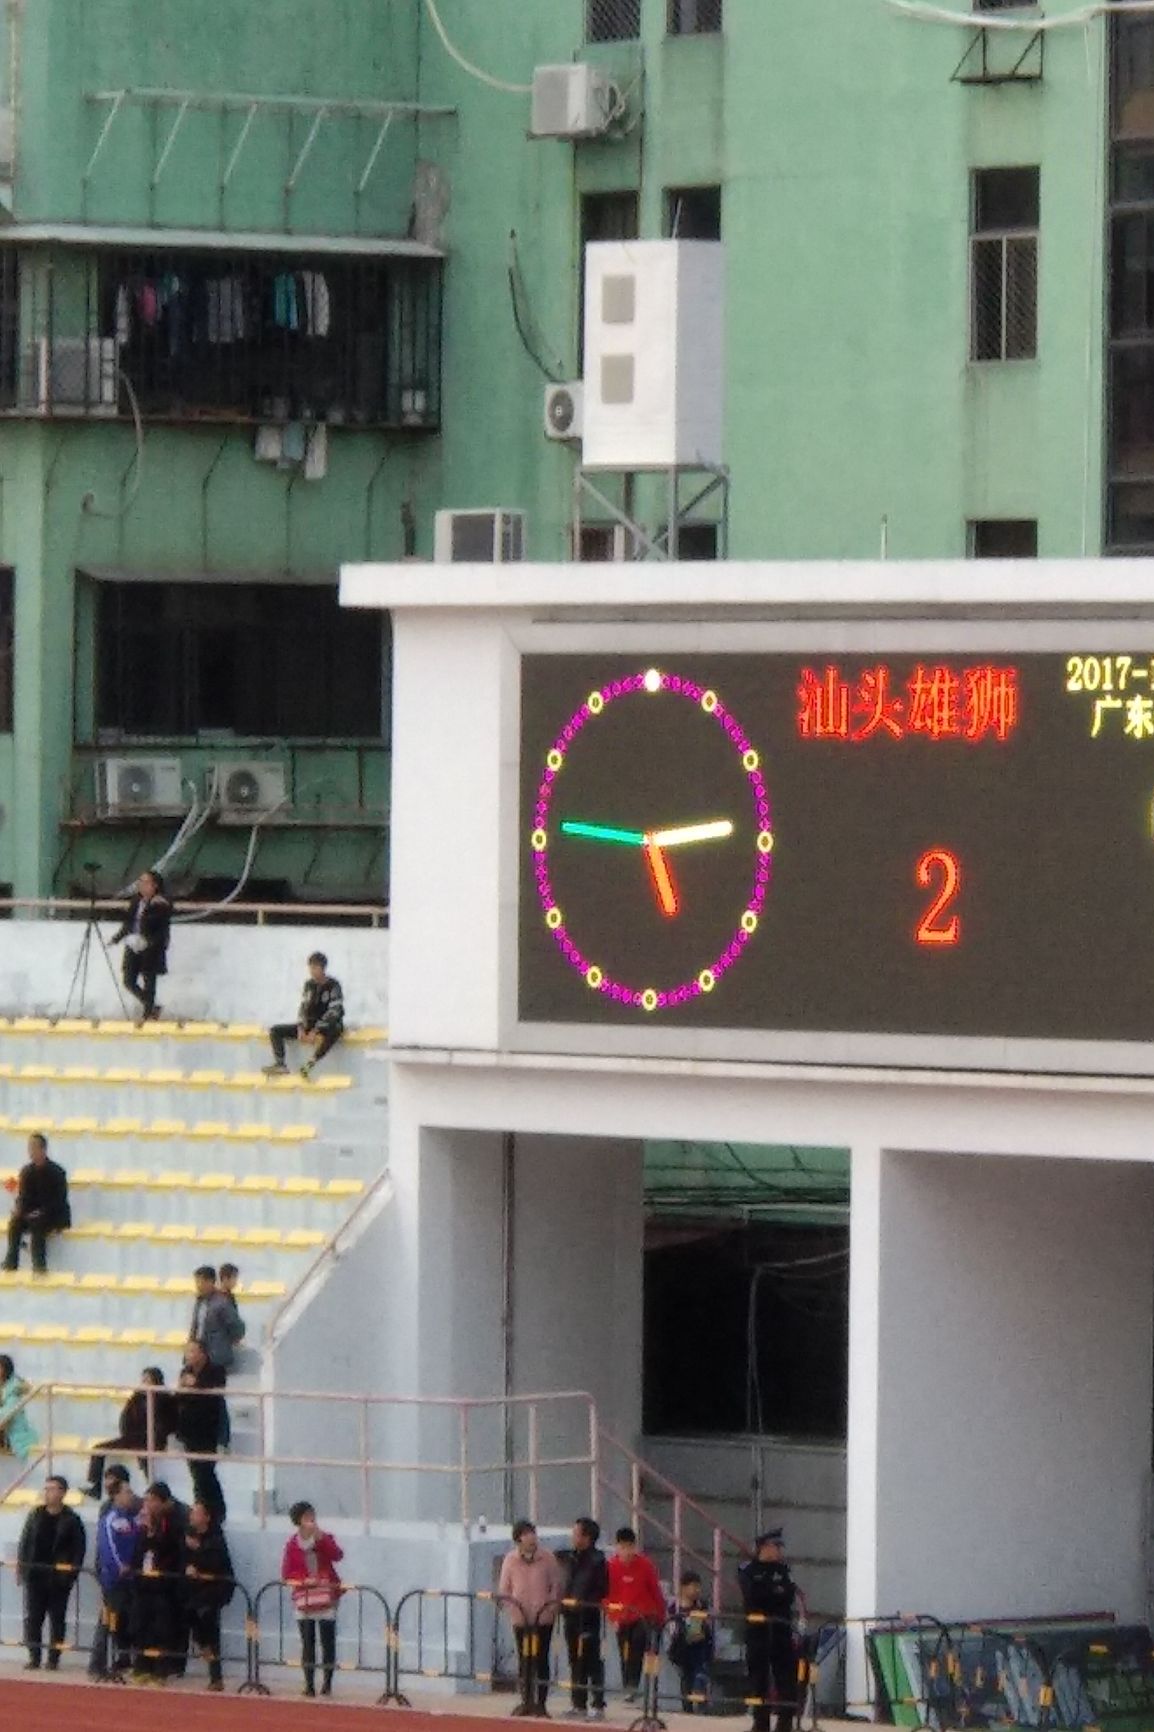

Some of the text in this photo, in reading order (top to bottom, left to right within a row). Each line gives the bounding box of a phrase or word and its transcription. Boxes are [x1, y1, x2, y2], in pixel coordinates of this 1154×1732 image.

[794, 662, 1021, 744] 汕头雄狮
[912, 846, 962, 947] 2
